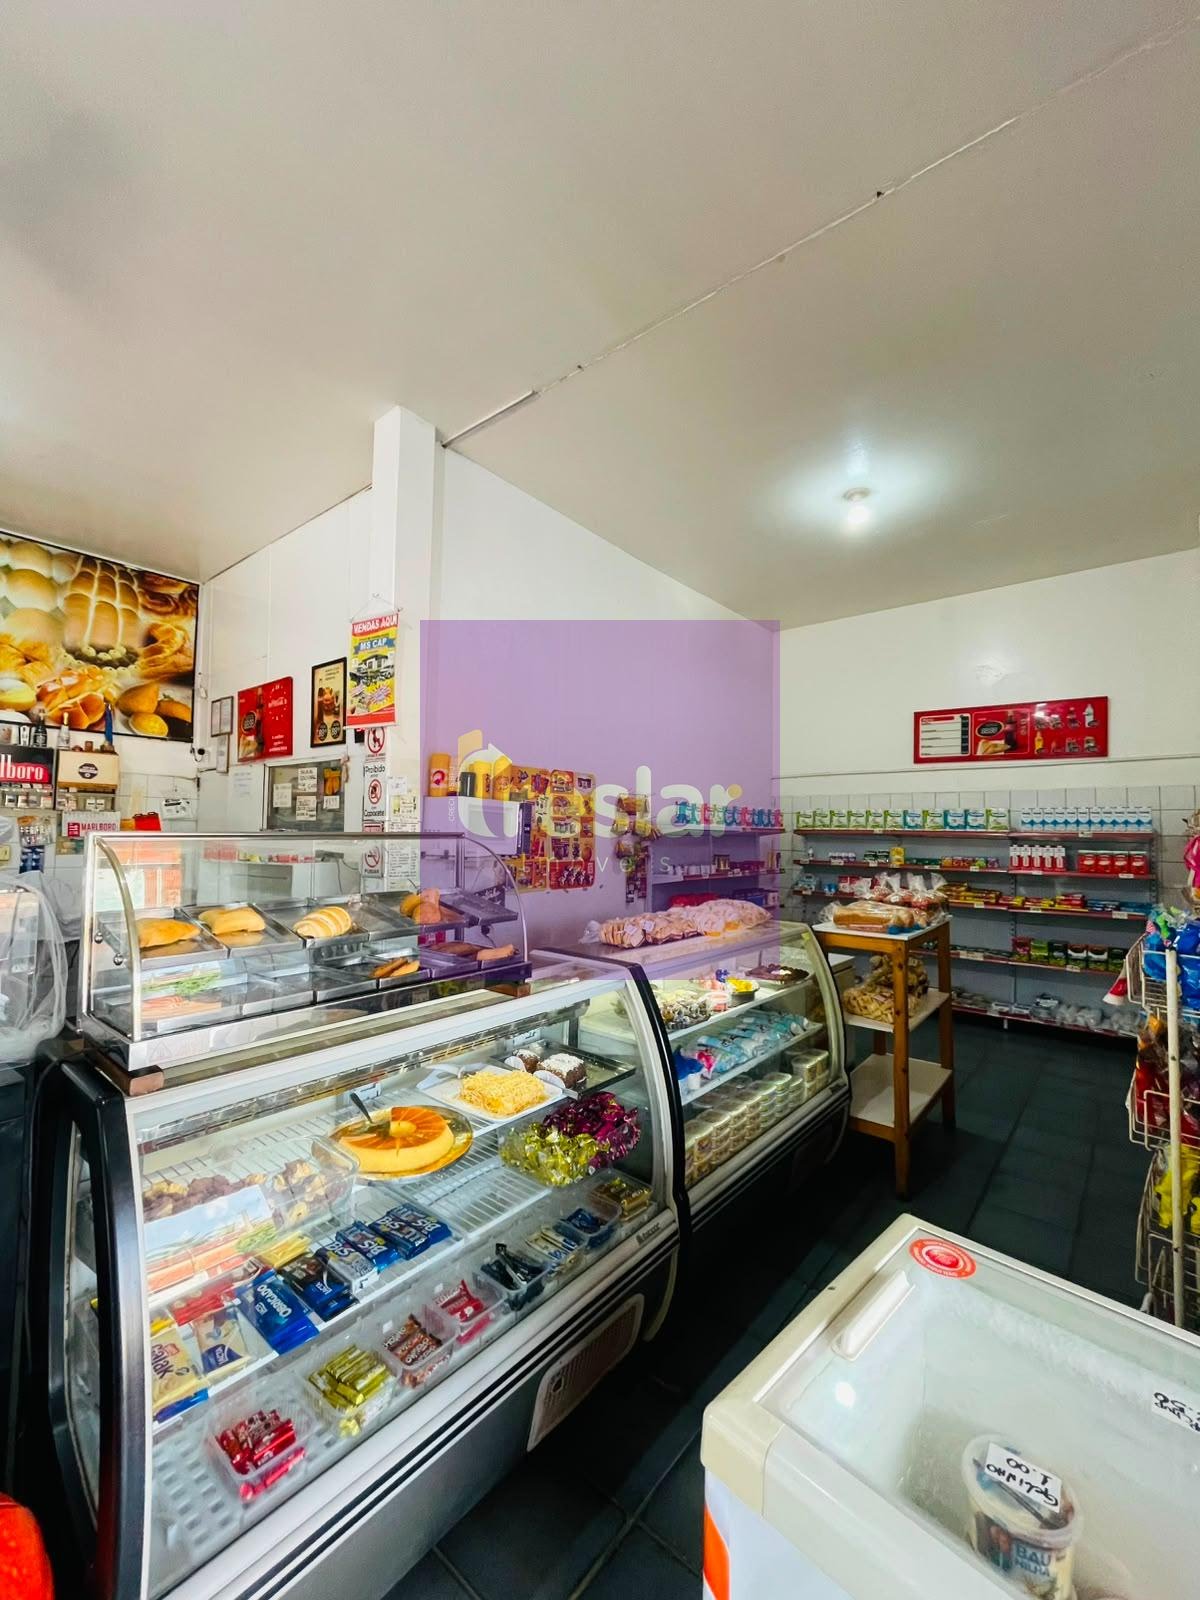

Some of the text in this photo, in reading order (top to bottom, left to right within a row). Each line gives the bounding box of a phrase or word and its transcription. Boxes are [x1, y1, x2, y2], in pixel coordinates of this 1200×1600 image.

[353, 614, 398, 634] VENDAS AQUI
[360, 637, 387, 650] MS CAP
[364, 764, 385, 775] Proibido
[81, 822, 117, 831] MARLBORO
[257, 1284, 292, 1317] OBRIGADO
[1016, 1543, 1051, 1567] BAU
